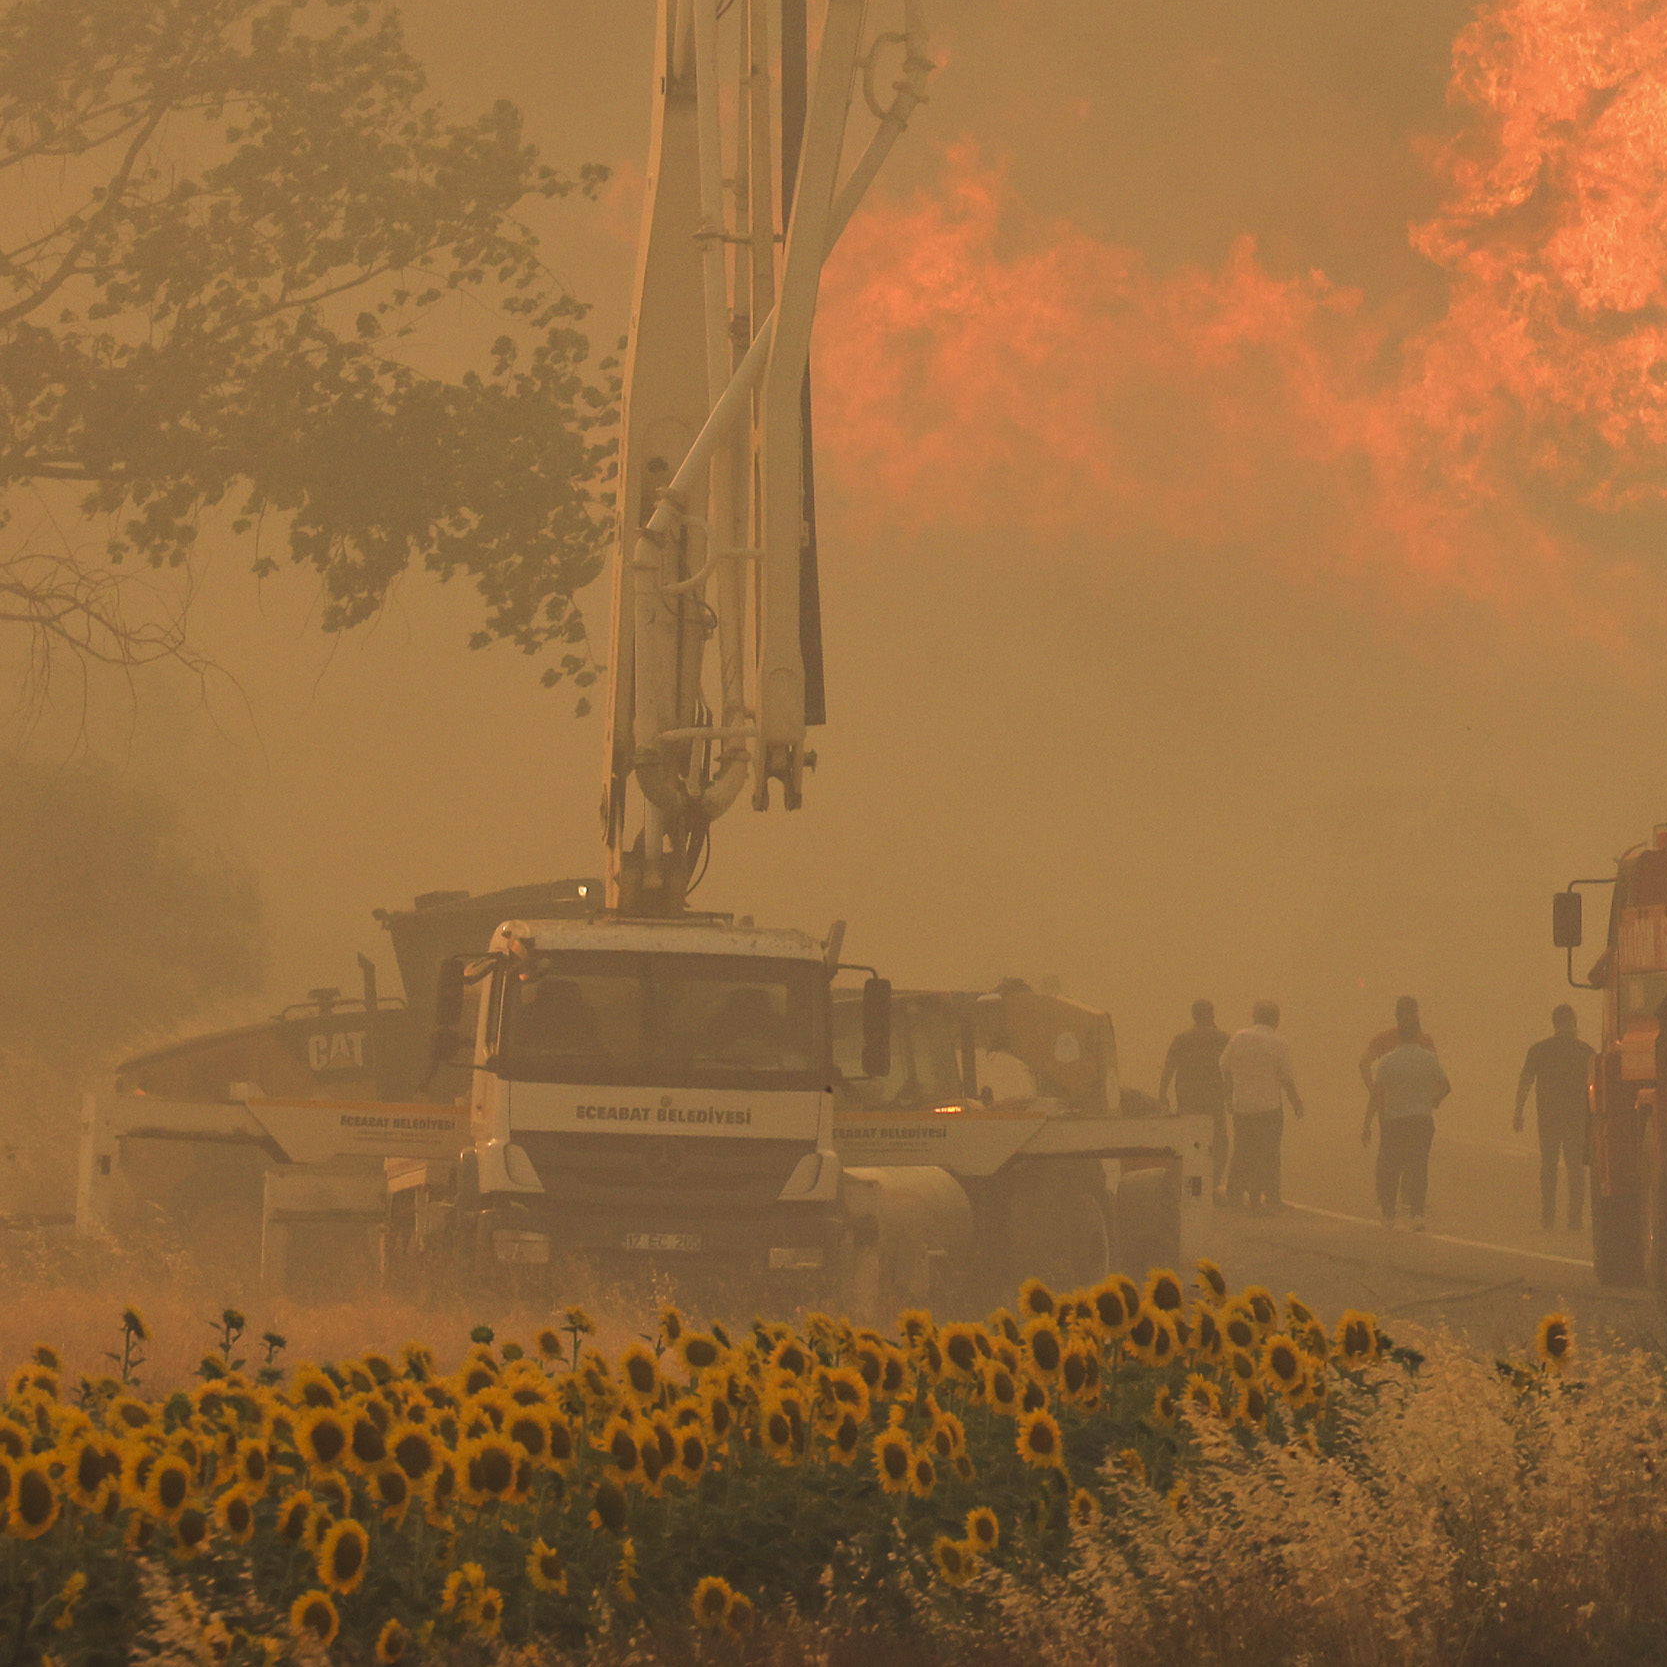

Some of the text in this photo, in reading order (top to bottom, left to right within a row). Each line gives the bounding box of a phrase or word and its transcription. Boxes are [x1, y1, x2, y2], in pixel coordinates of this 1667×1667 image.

[308, 1030, 366, 1071] CAT
[340, 1115, 456, 1131] ECEABAT BELEDİYESİ
[576, 1105, 752, 1125] ECEABAT BELEDİYESİ
